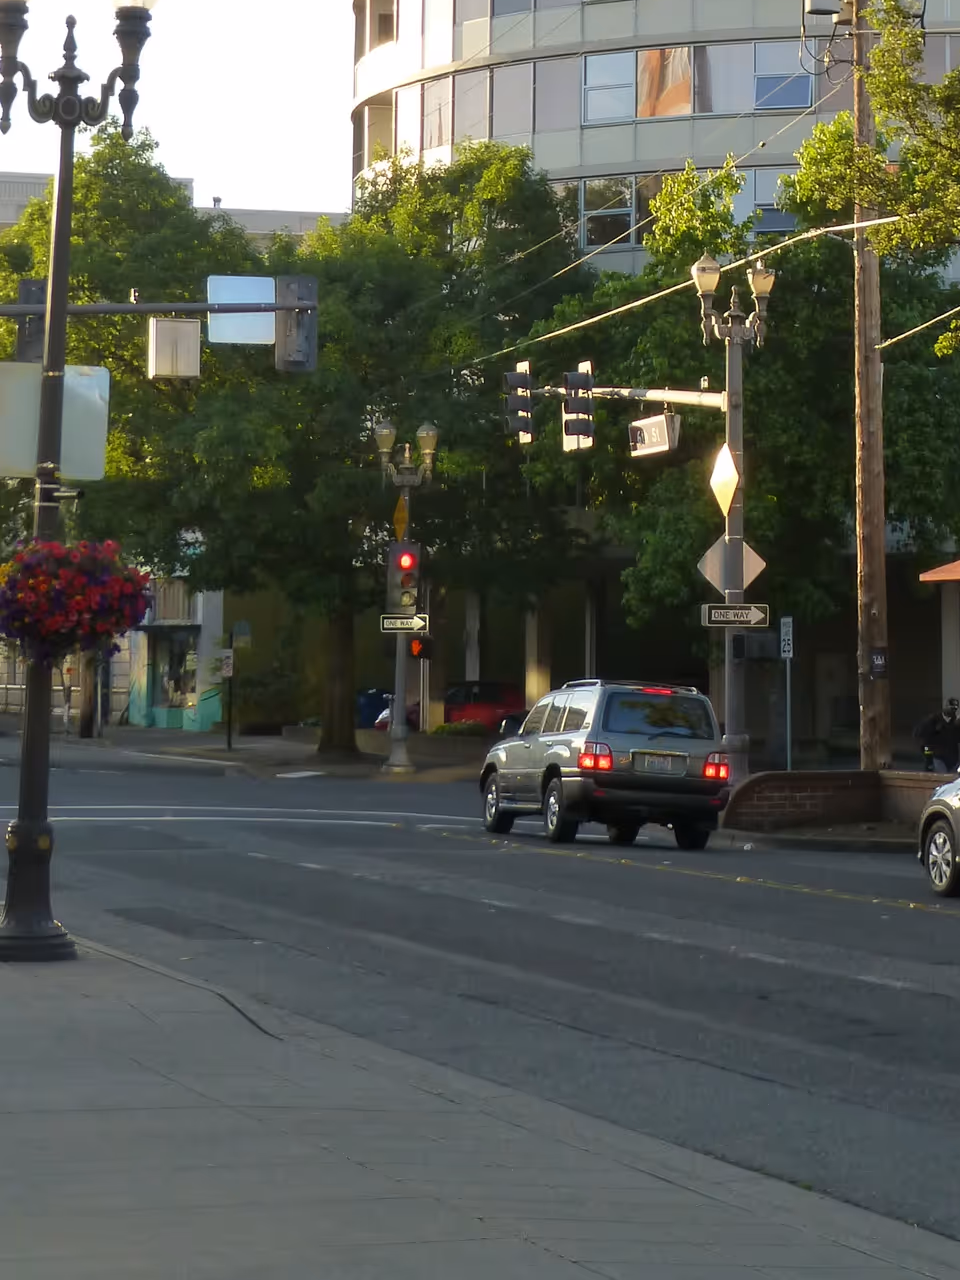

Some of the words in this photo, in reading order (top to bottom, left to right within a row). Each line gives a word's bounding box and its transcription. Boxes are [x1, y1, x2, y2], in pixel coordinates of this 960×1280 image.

[713, 611, 731, 619] ONE
[732, 610, 750, 619] WAY
[782, 638, 792, 654] 25
